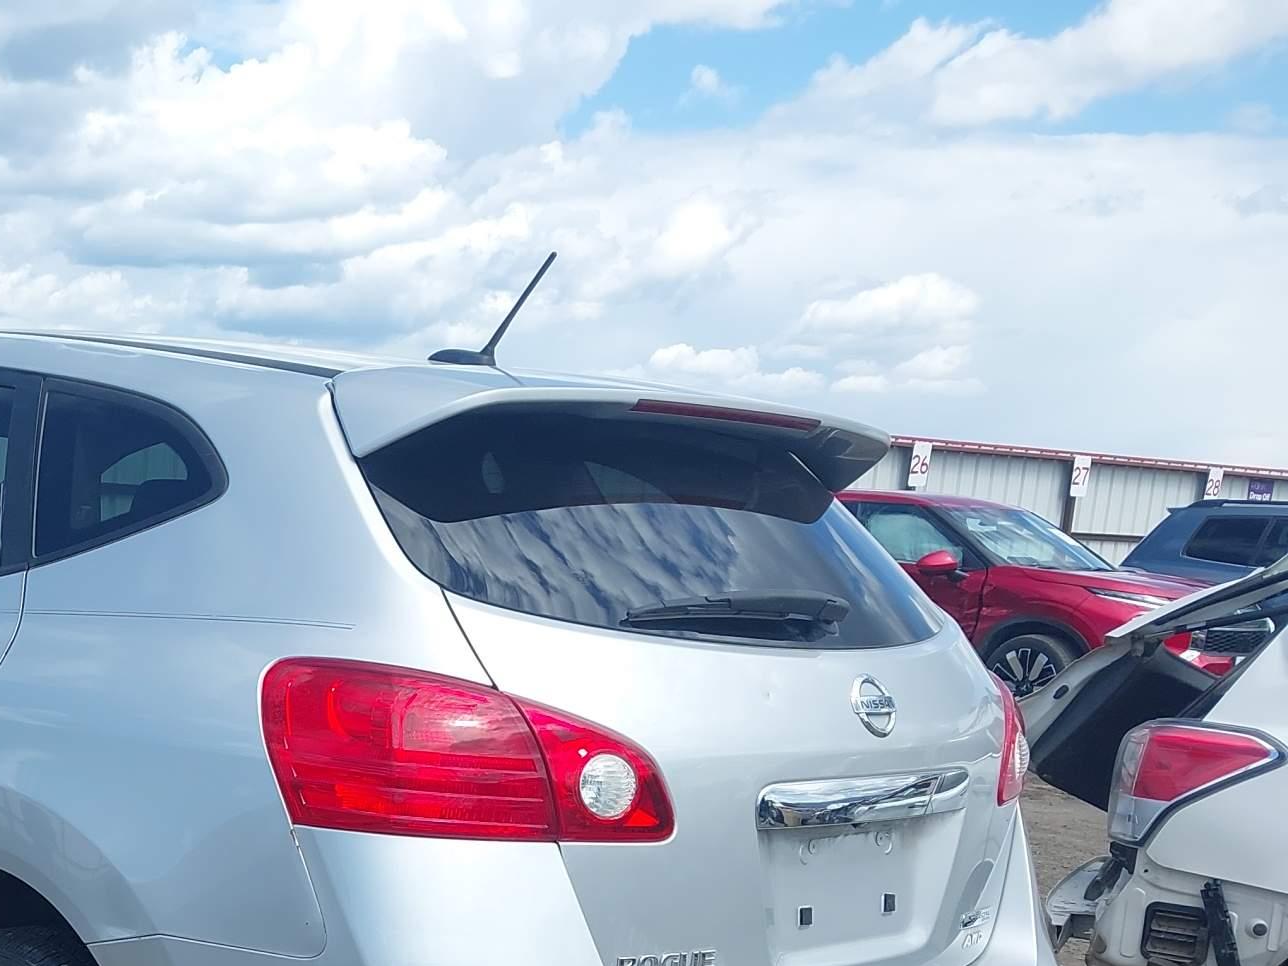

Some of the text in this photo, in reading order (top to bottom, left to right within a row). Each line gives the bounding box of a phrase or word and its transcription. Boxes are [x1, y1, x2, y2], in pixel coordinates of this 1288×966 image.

[910, 454, 929, 474] 26
[1071, 466, 1090, 486] 27
[1205, 478, 1221, 497] 28
